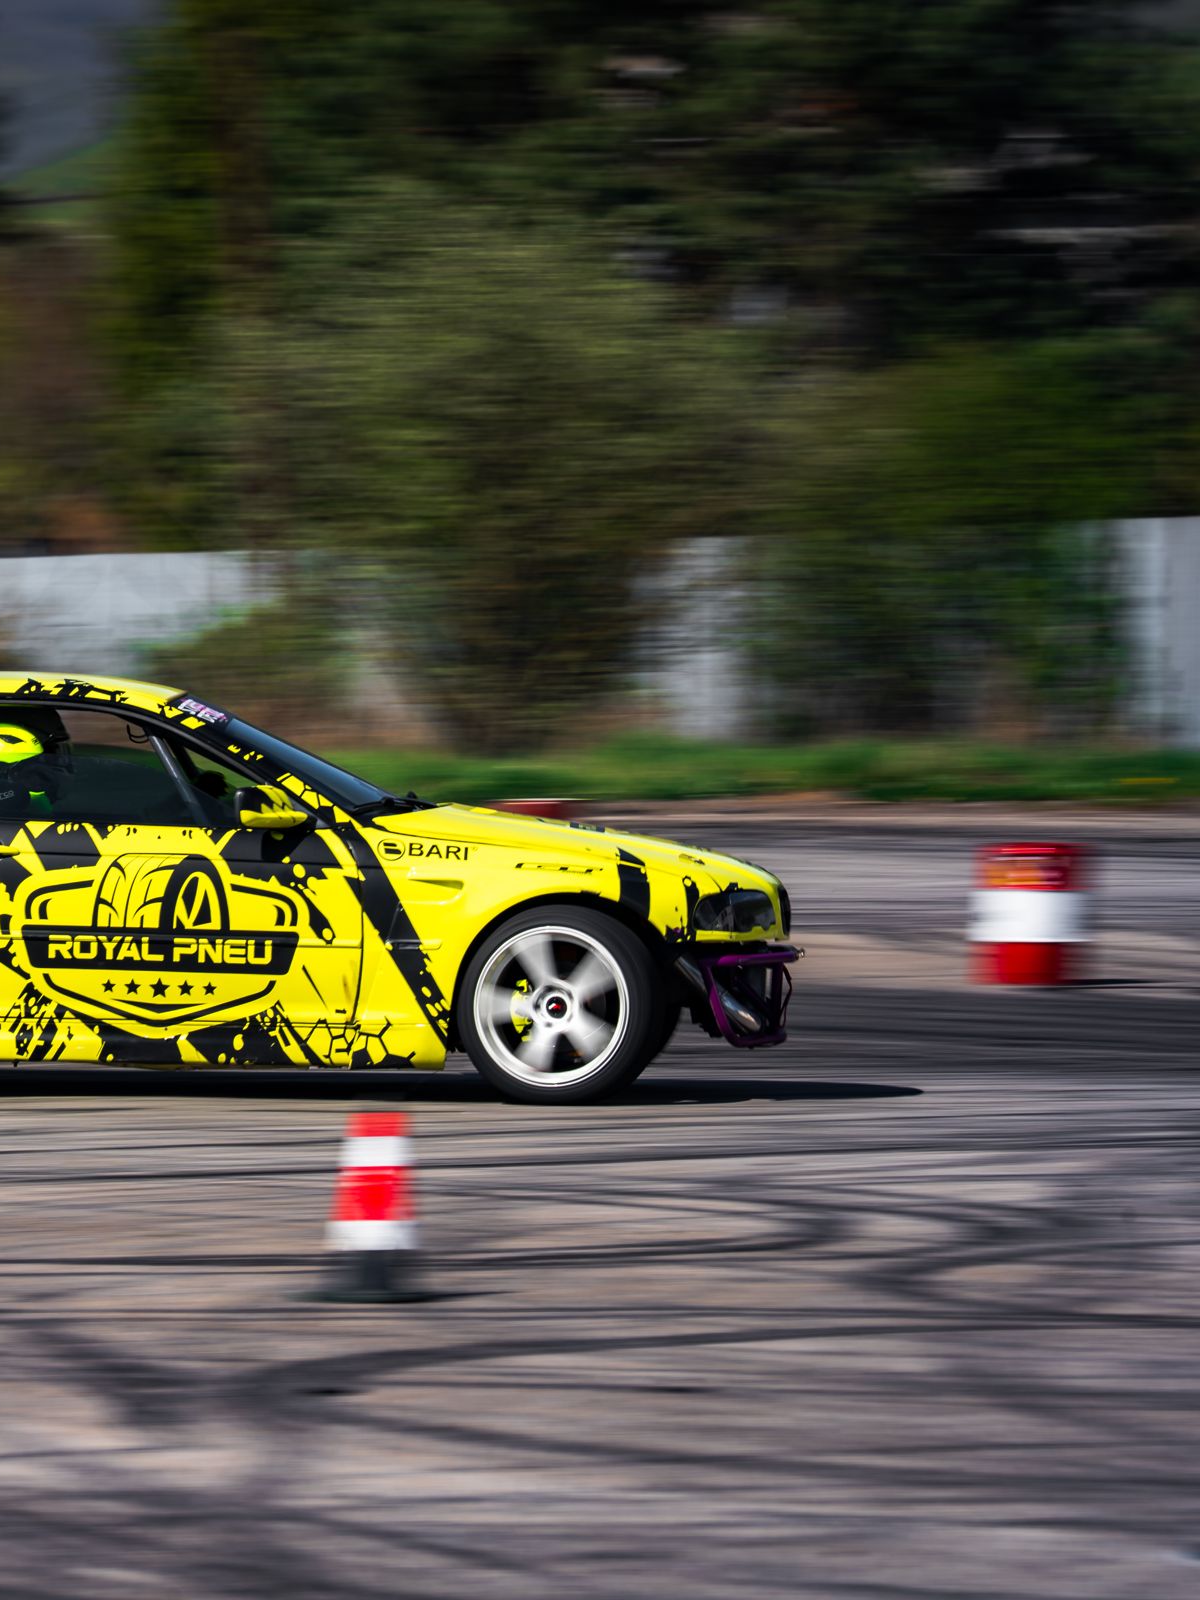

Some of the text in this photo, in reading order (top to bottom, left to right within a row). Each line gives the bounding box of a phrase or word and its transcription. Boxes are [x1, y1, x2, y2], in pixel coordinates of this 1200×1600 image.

[408, 842, 469, 861] BARI
[48, 933, 273, 965] ROYAL PNEU
